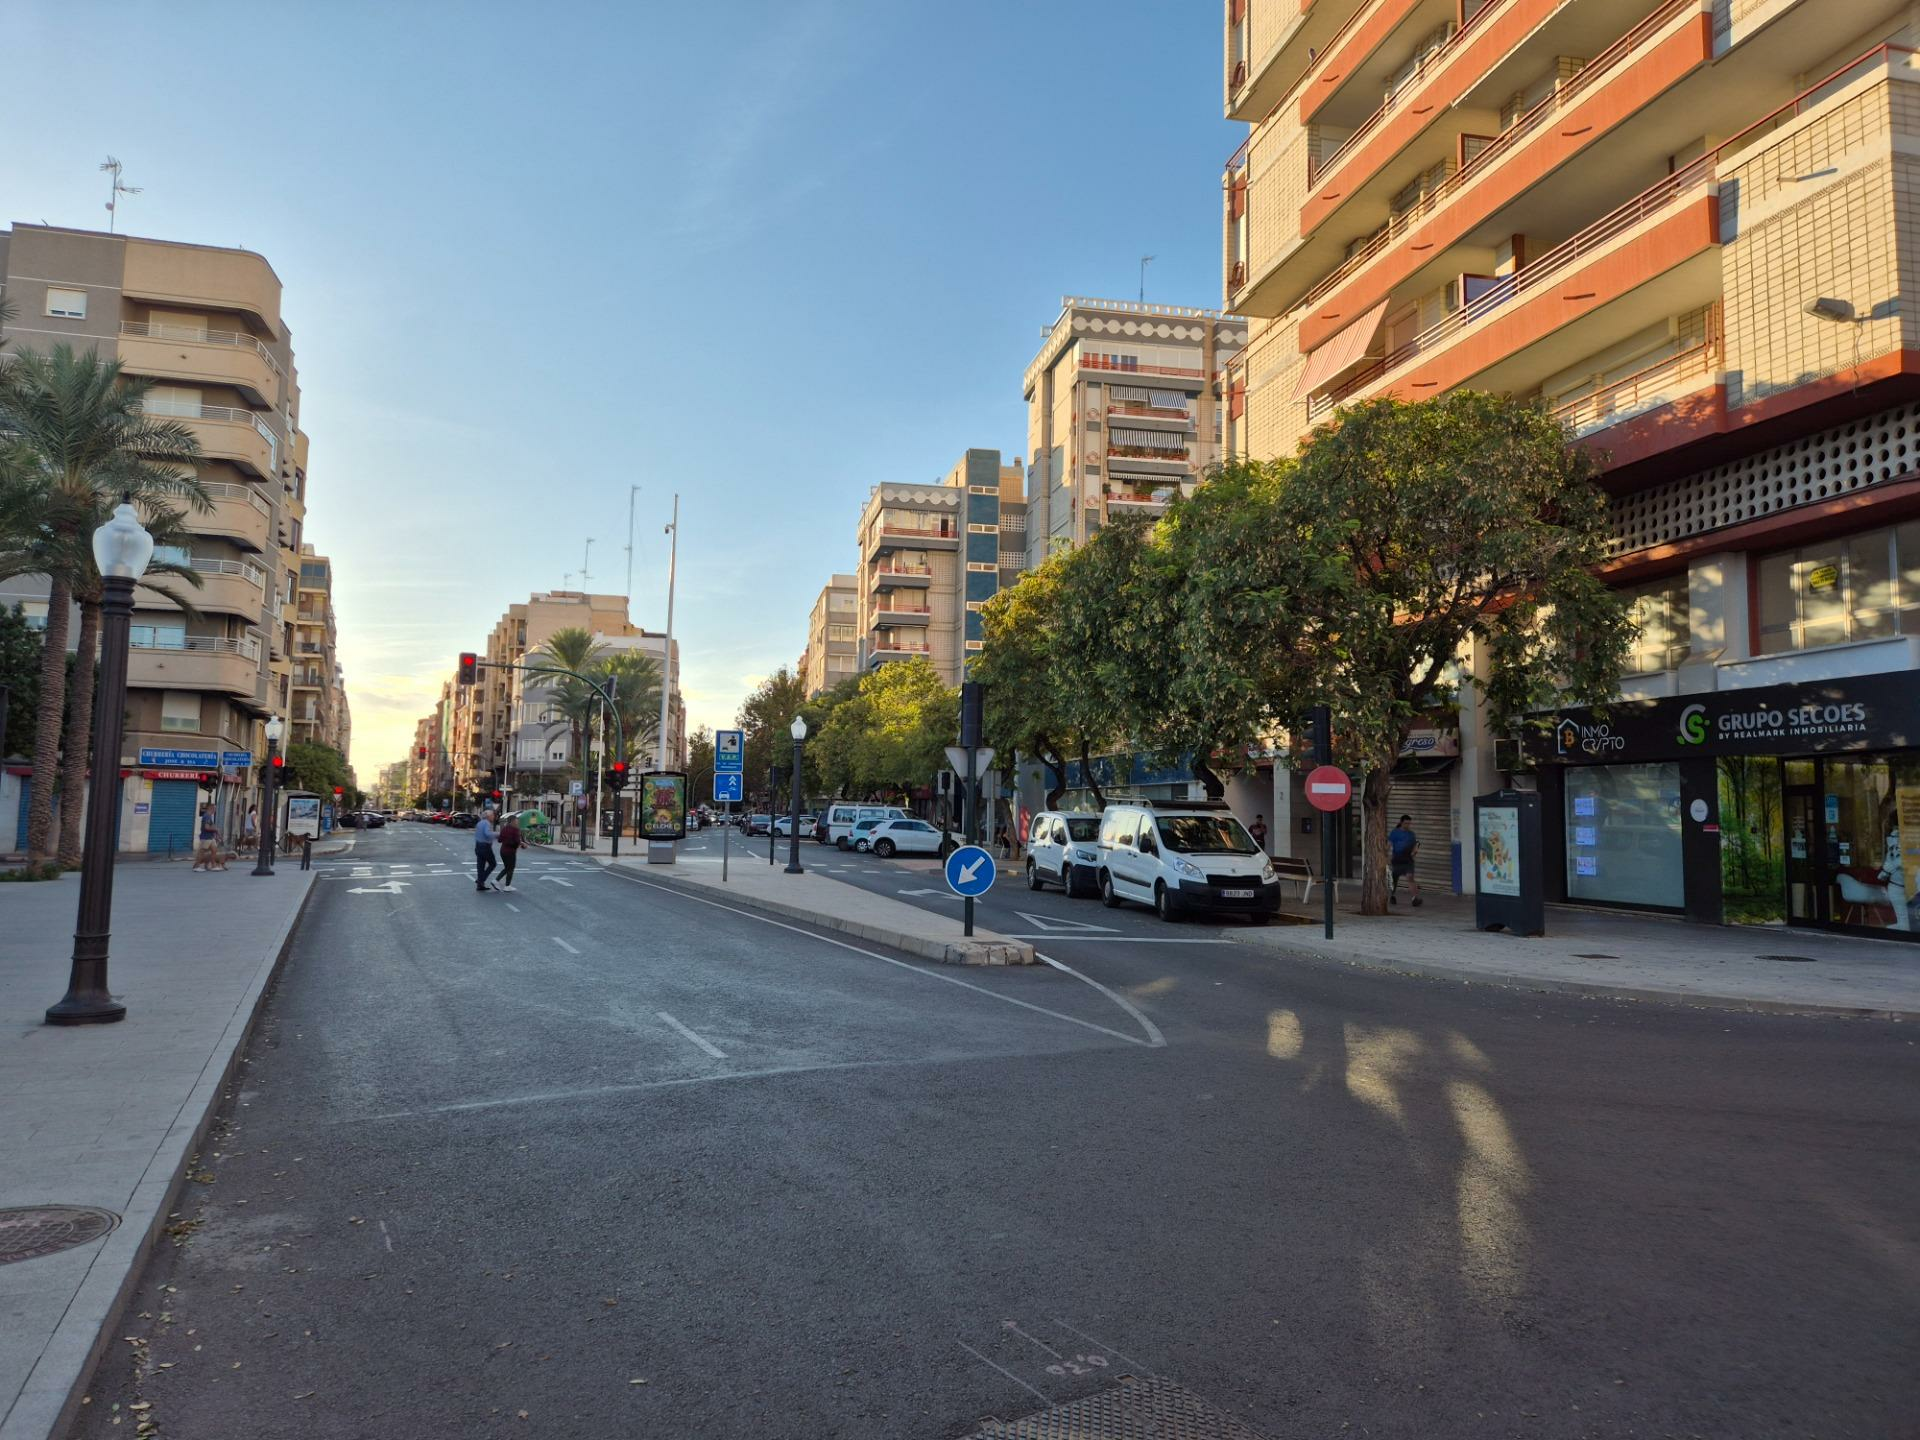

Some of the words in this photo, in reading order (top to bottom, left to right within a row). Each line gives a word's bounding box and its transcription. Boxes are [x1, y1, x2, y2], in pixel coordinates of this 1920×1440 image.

[1718, 710, 1783, 731] GRUPO
[1788, 703, 1866, 726] SECOES
[1581, 724, 1609, 738] INMO
[1718, 732, 1730, 740] BY
[1734, 729, 1785, 739] REALMARK
[1789, 723, 1867, 735] INMOBILIARIA
[572, 782, 582, 793] P
